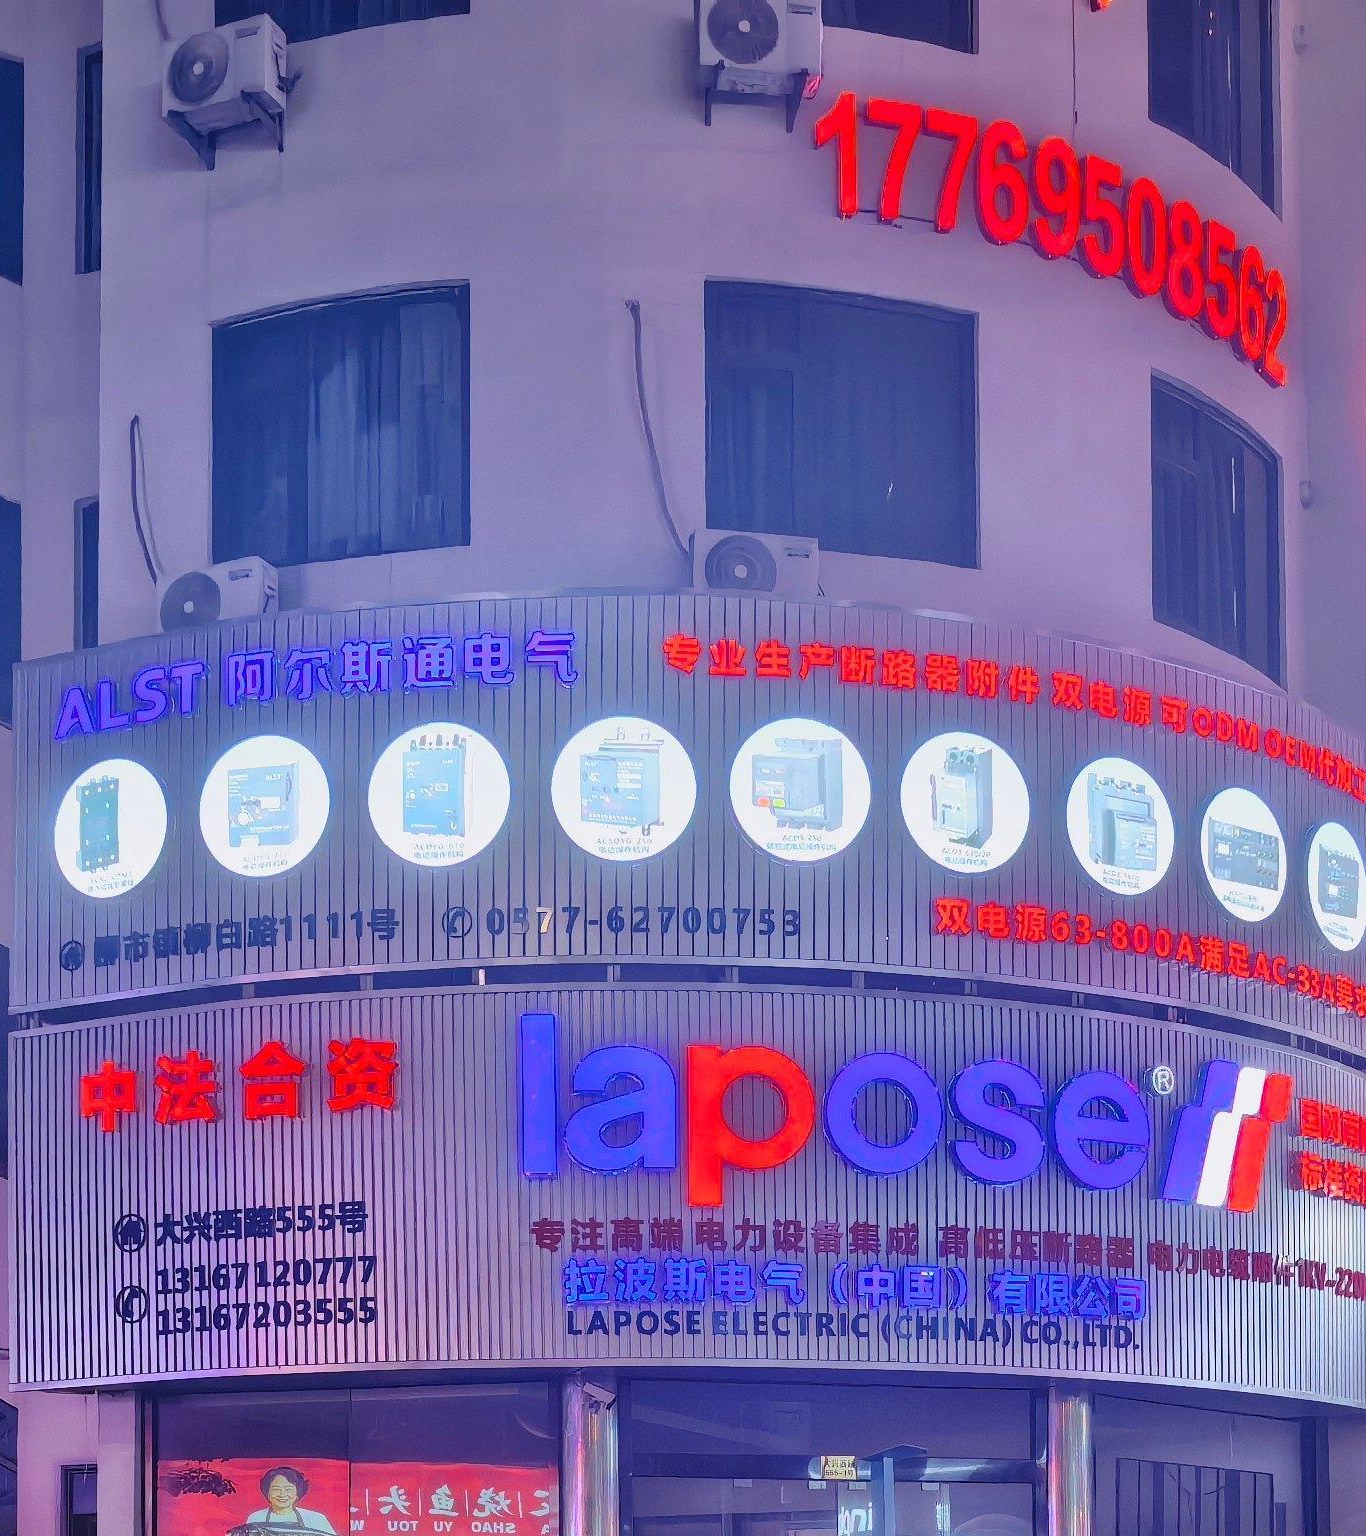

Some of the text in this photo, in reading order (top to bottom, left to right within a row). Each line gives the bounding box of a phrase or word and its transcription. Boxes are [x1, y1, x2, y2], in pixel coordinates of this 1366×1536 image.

[815, 91, 1287, 388] 17769508562
[55, 630, 579, 740] ALST 阿尔斯通电气
[663, 633, 1039, 704] 专业生产断路器附件
[1052, 672, 1151, 726] 双电源
[487, 906, 799, 936] 0577-62700753
[80, 1037, 398, 1133] 中法合资
[519, 1012, 1154, 1208] lapose
[154, 1200, 369, 1247] 大兴西路555号
[156, 1255, 377, 1295] 13167120777
[156, 1296, 378, 1335] 13167203555
[567, 1310, 702, 1336] LAPOSE
[712, 1311, 870, 1338] ELECTRIC
[881, 1314, 1012, 1347] (CHINA)
